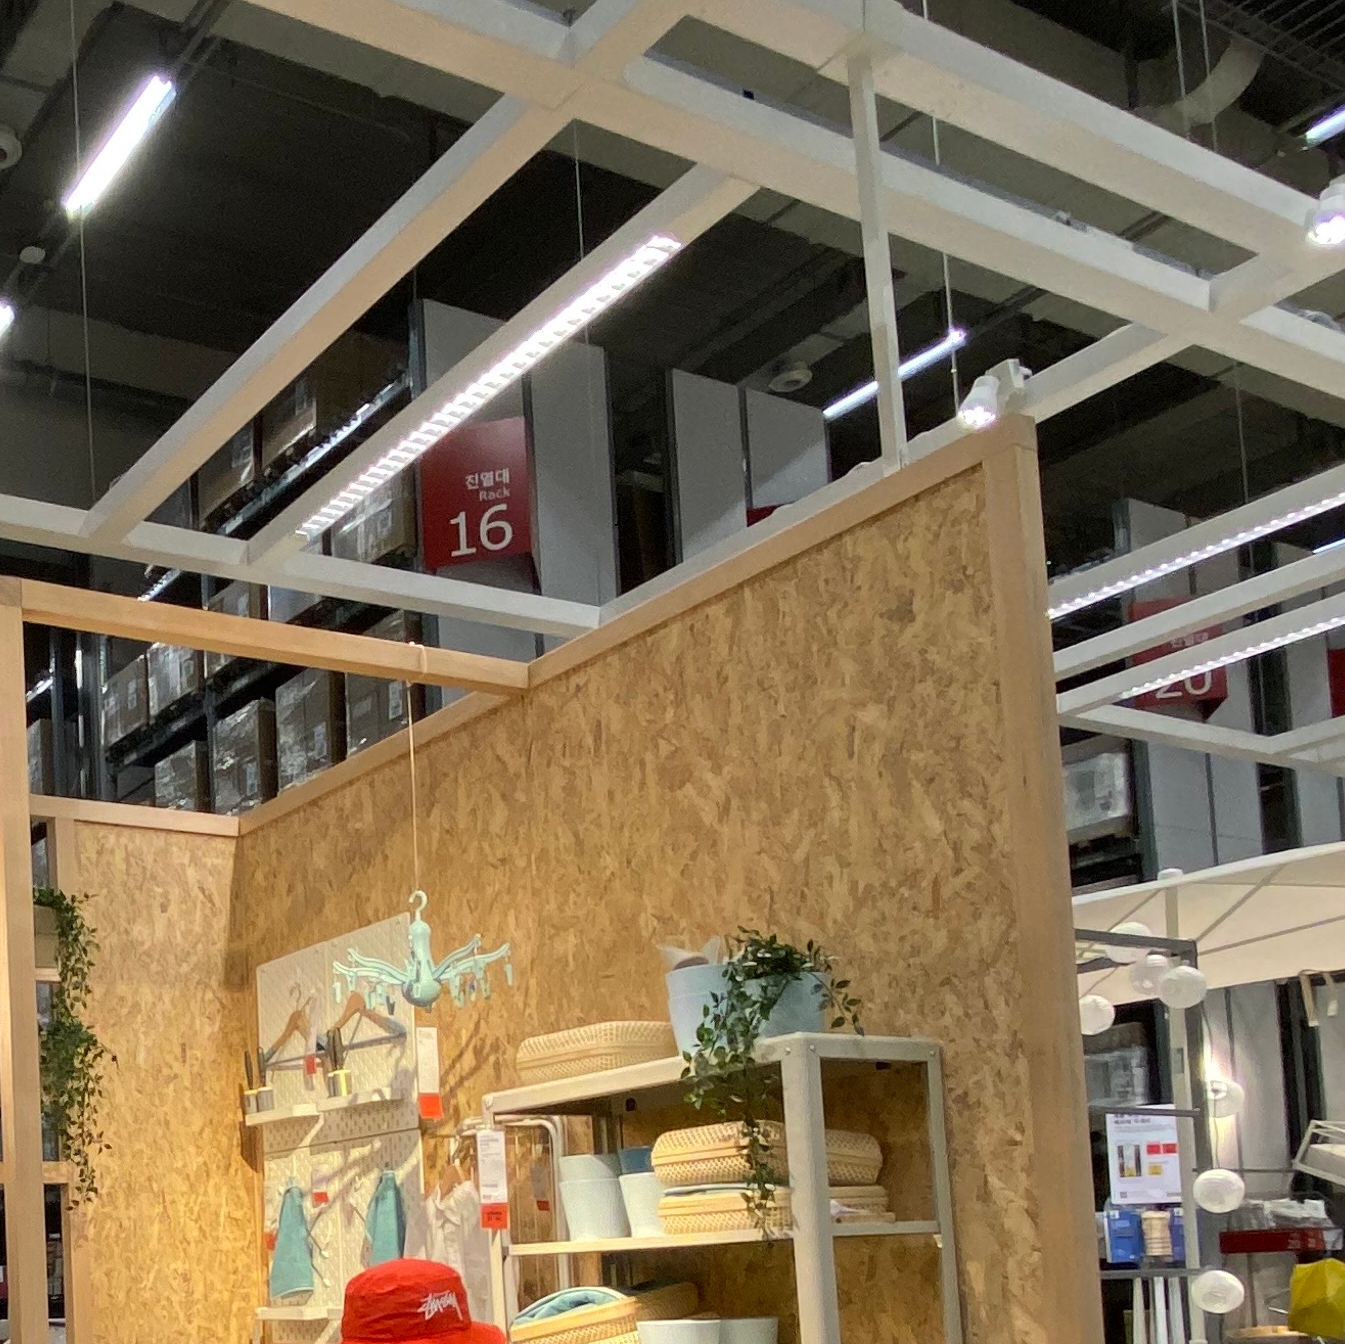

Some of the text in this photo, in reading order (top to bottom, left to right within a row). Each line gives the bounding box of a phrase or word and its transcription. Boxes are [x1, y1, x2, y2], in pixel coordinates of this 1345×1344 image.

[465, 467, 510, 490] 진열대
[478, 486, 510, 501] Rack
[449, 503, 513, 557] 16
